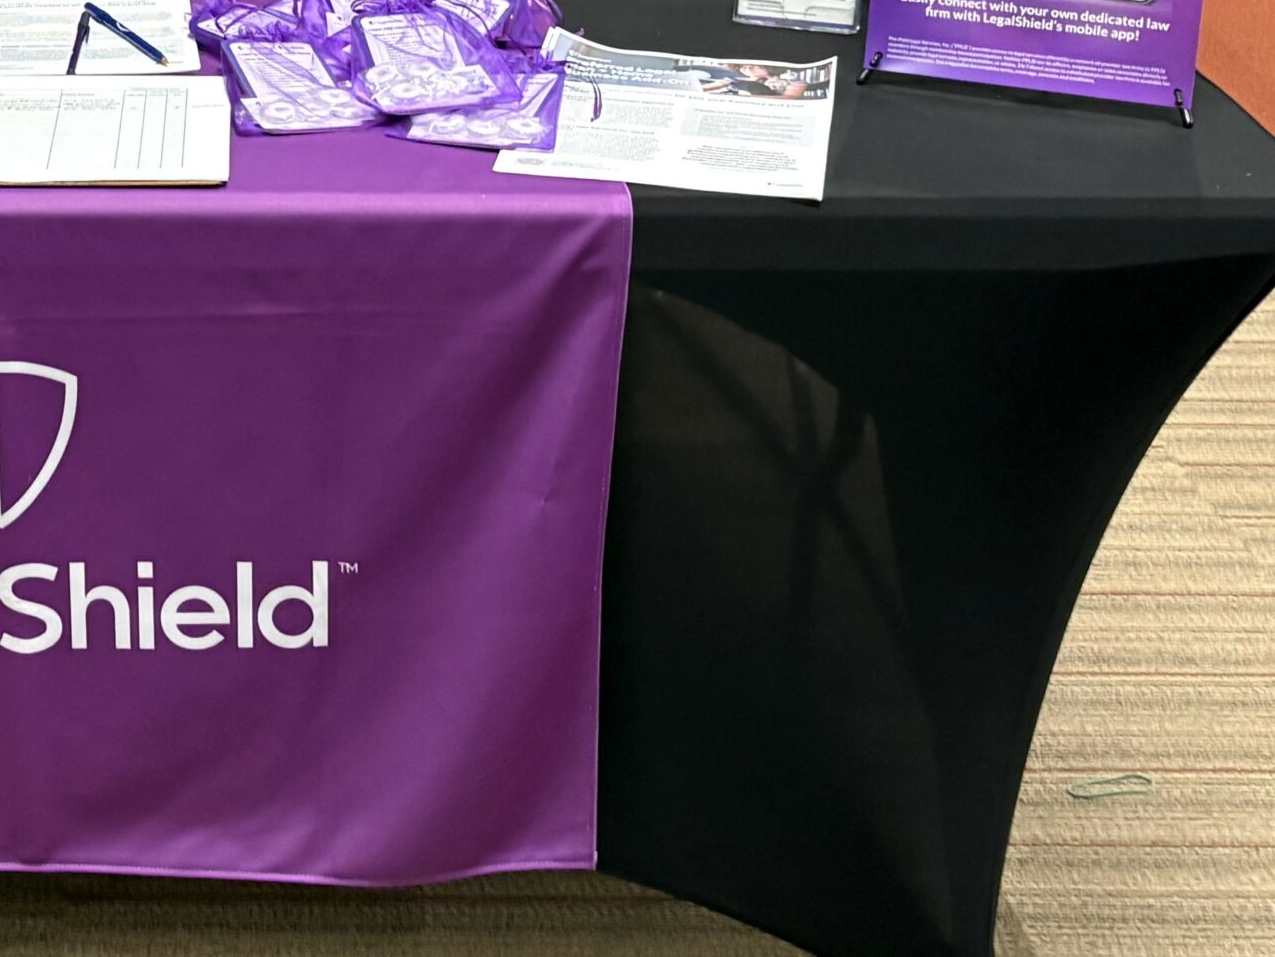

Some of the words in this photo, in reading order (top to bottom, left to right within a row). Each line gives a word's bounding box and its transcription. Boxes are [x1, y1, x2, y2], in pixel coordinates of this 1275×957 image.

[925, 7, 951, 22] firm
[953, 9, 981, 25] with
[983, 12, 1063, 34] LegalShield's
[1065, 20, 1108, 38] mobile
[1111, 28, 1140, 43] app!
[989, 0, 1017, 15] with
[1019, 5, 1049, 20] your
[1051, 8, 1078, 21] own
[1080, 9, 1142, 29] dedicated
[1146, 15, 1171, 32] law
